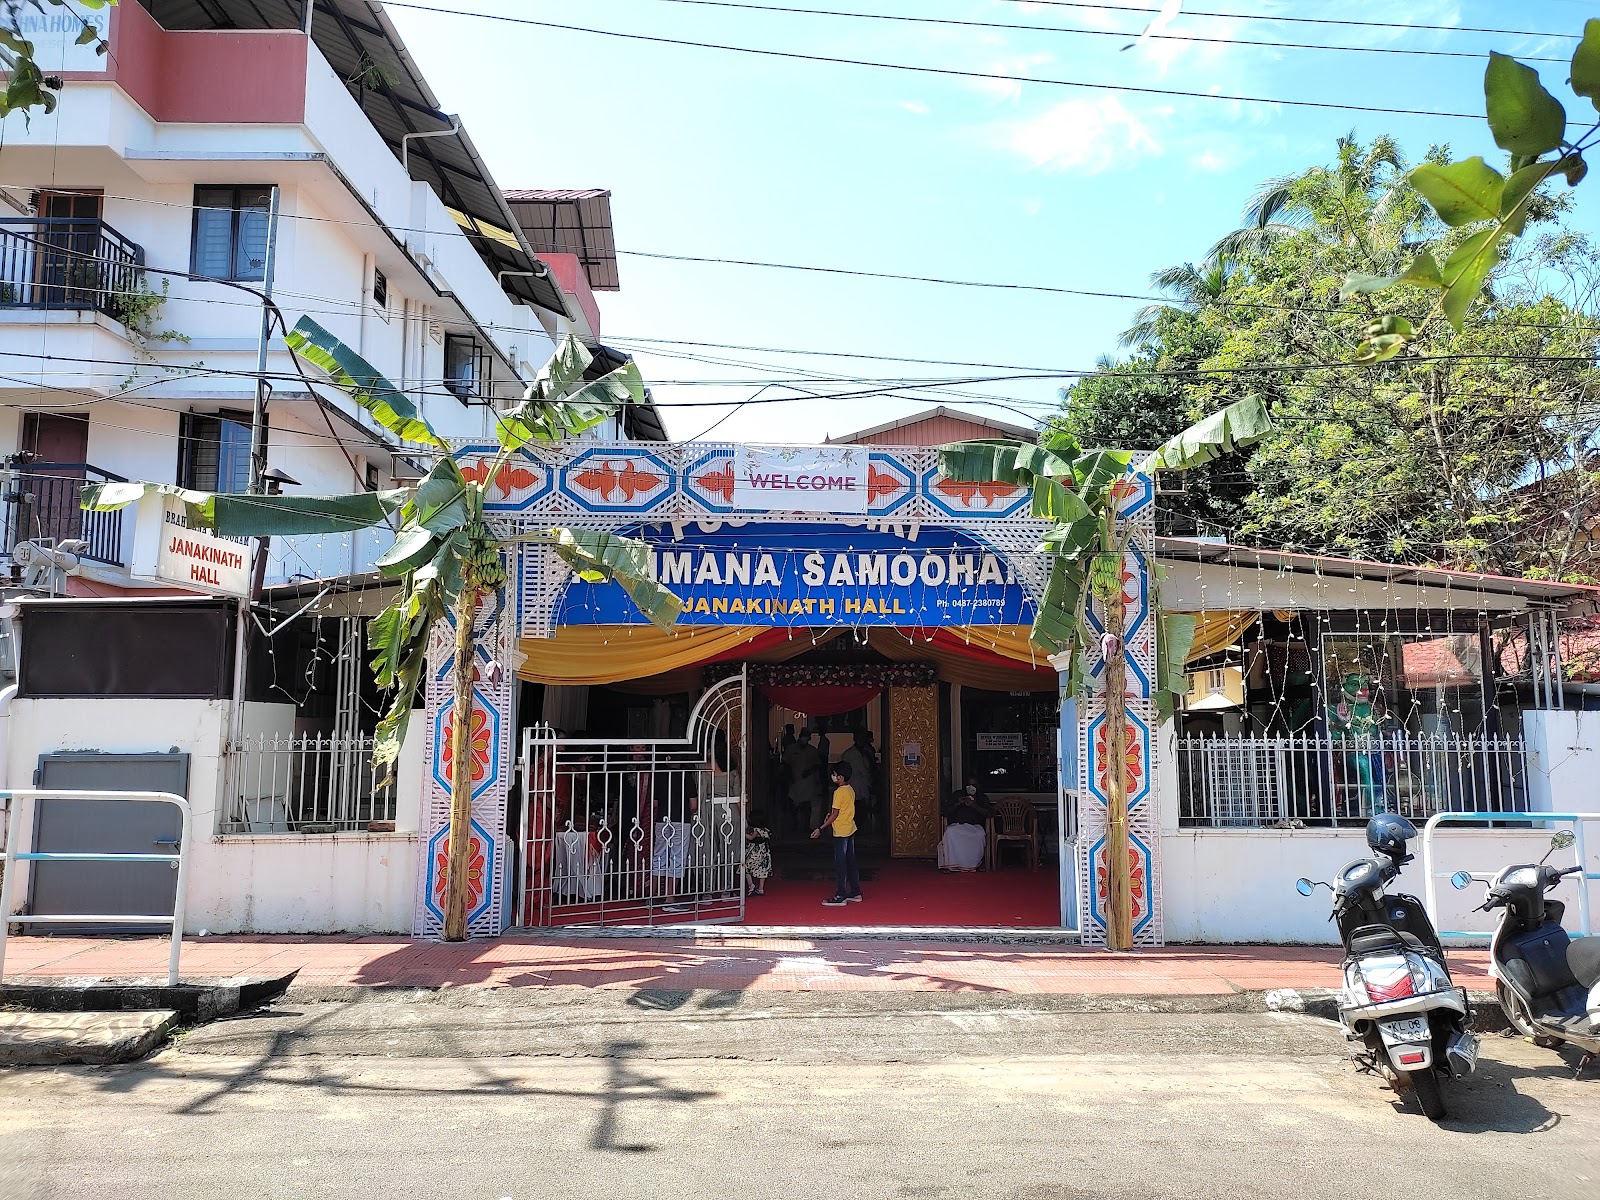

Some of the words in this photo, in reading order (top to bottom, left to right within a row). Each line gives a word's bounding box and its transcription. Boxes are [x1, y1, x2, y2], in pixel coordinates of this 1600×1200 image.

[749, 473, 857, 491] WELCOME
[169, 536, 243, 569] JANAKINATH
[190, 563, 220, 585] HALL
[681, 597, 835, 615] JANAKINATH
[844, 598, 907, 615] HALL
[952, 599, 1006, 608] 0487-2380789
[1391, 1022, 1406, 1033] KL
[1408, 1019, 1421, 1030] 08
